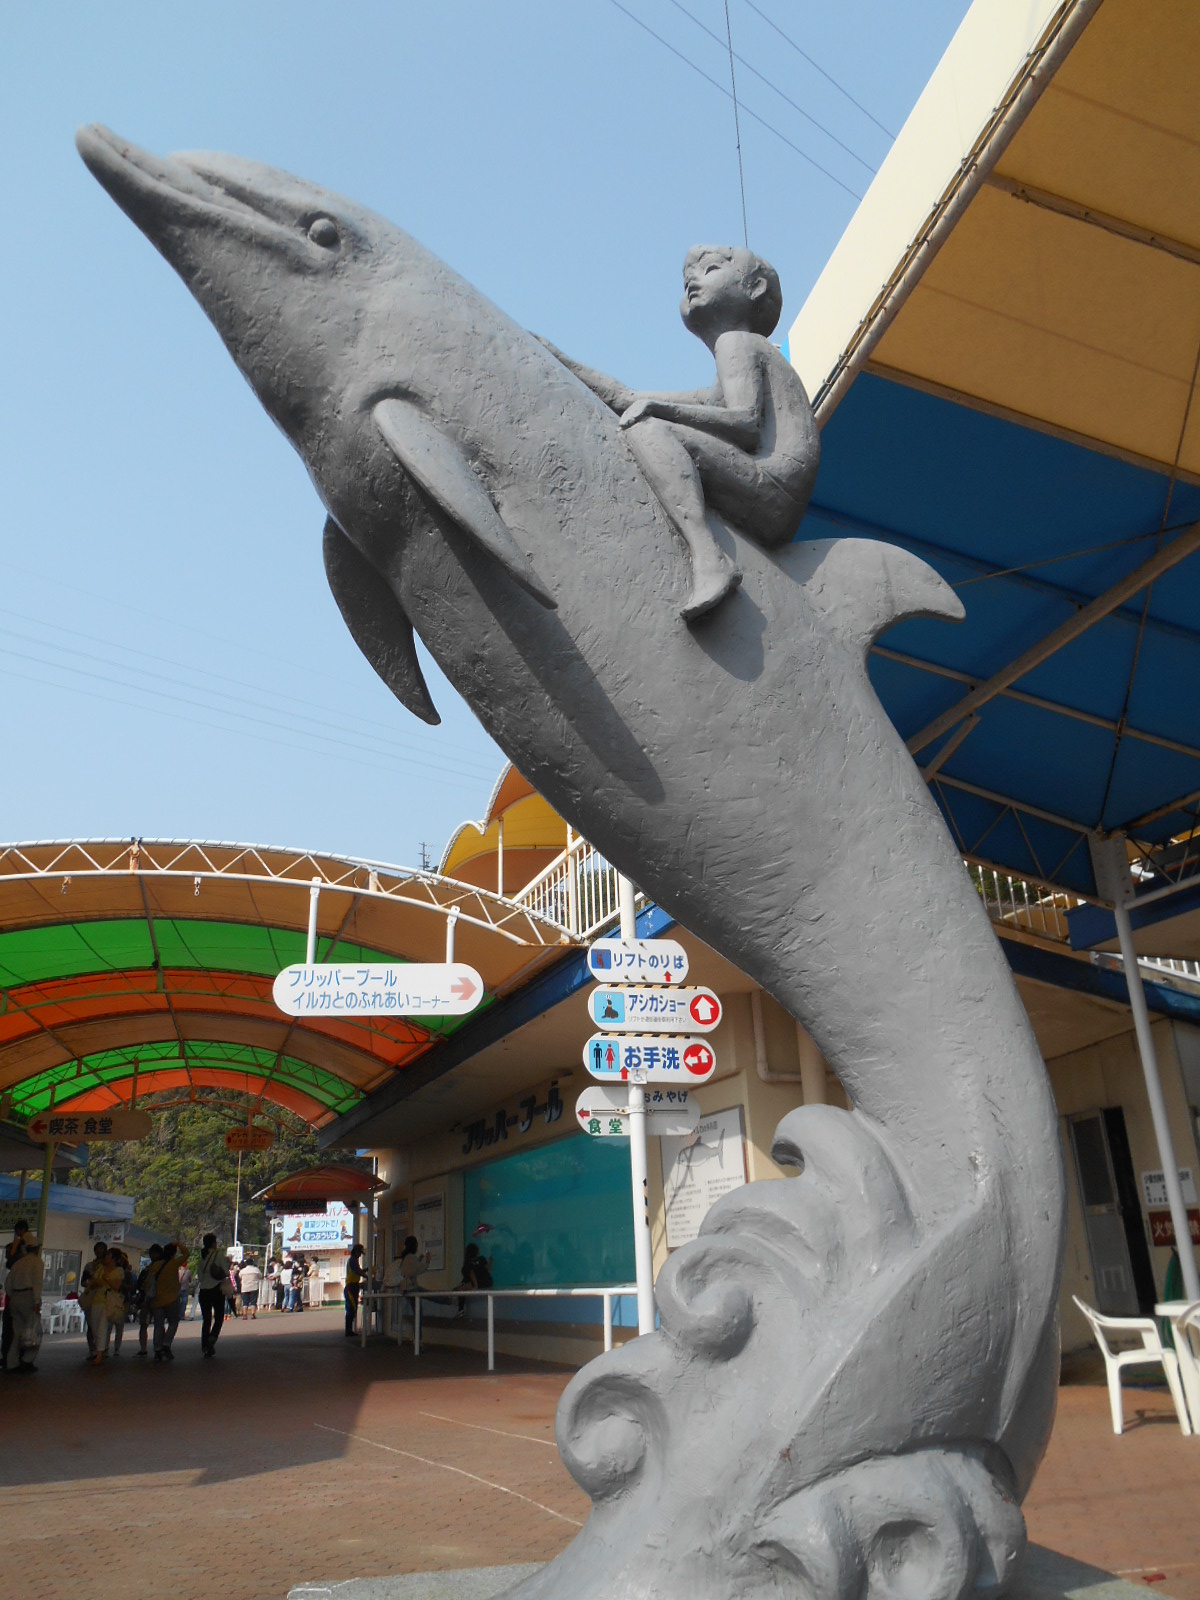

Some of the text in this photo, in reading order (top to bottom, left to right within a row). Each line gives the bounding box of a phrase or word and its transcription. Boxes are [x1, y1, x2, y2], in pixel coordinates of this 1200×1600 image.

[613, 952, 684, 969] リフトのりば
[288, 970, 397, 988] フリッパープール
[628, 994, 686, 1013] アシカショー
[624, 1046, 680, 1070] お手洗
[48, 1117, 113, 1135] 喫茶 食堂
[587, 1118, 623, 1134] 食堂
